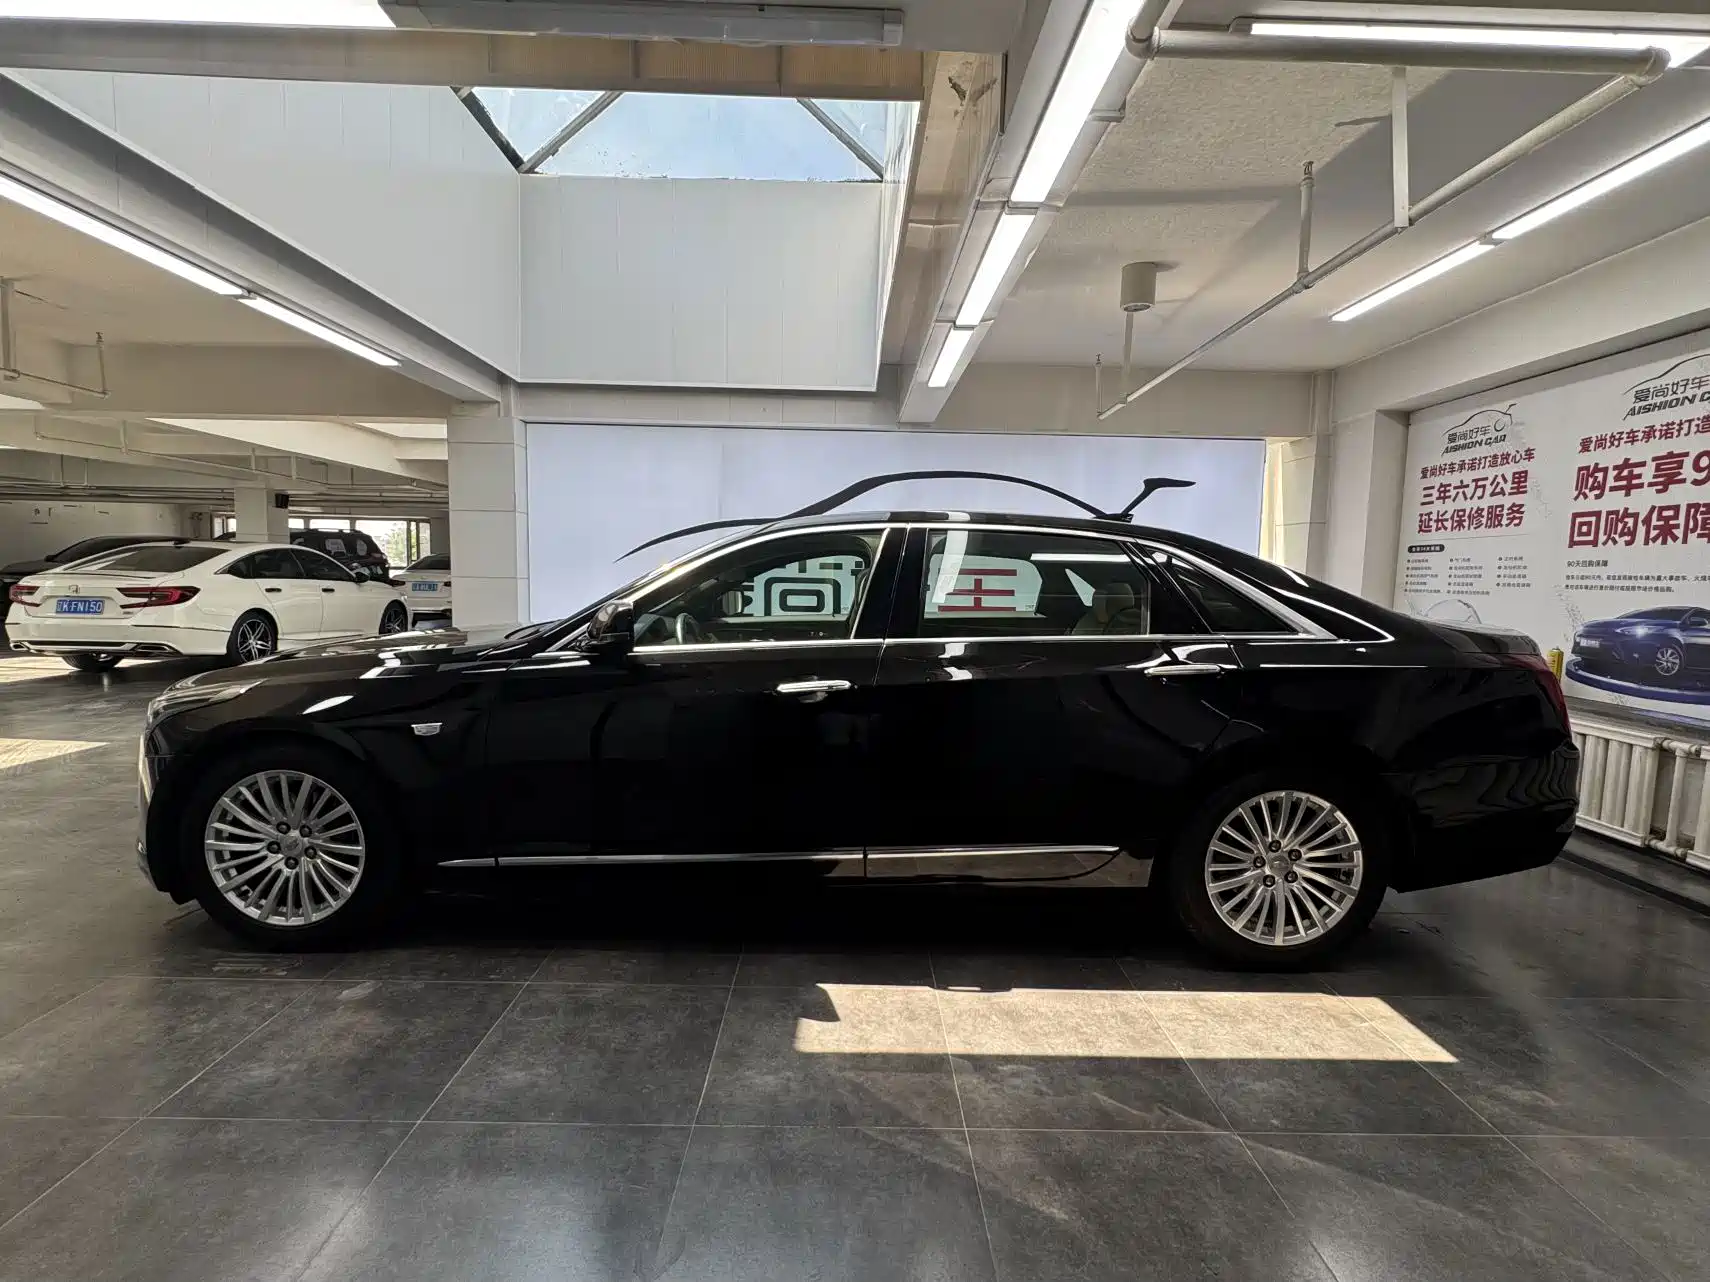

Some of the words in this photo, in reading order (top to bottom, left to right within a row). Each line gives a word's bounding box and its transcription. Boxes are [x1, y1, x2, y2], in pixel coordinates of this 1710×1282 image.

[1632, 374, 1710, 404] 爱尚好车
[1622, 391, 1698, 420] AISHION
[1441, 440, 1483, 456] AISHION
[1484, 434, 1507, 447] CAR
[1447, 425, 1491, 444] 爱尚好车
[1419, 447, 1536, 480] 爱尚好车承诺打造放心车
[1420, 470, 1529, 506] 三年六万公里
[1417, 502, 1526, 534] 延长保修服务
